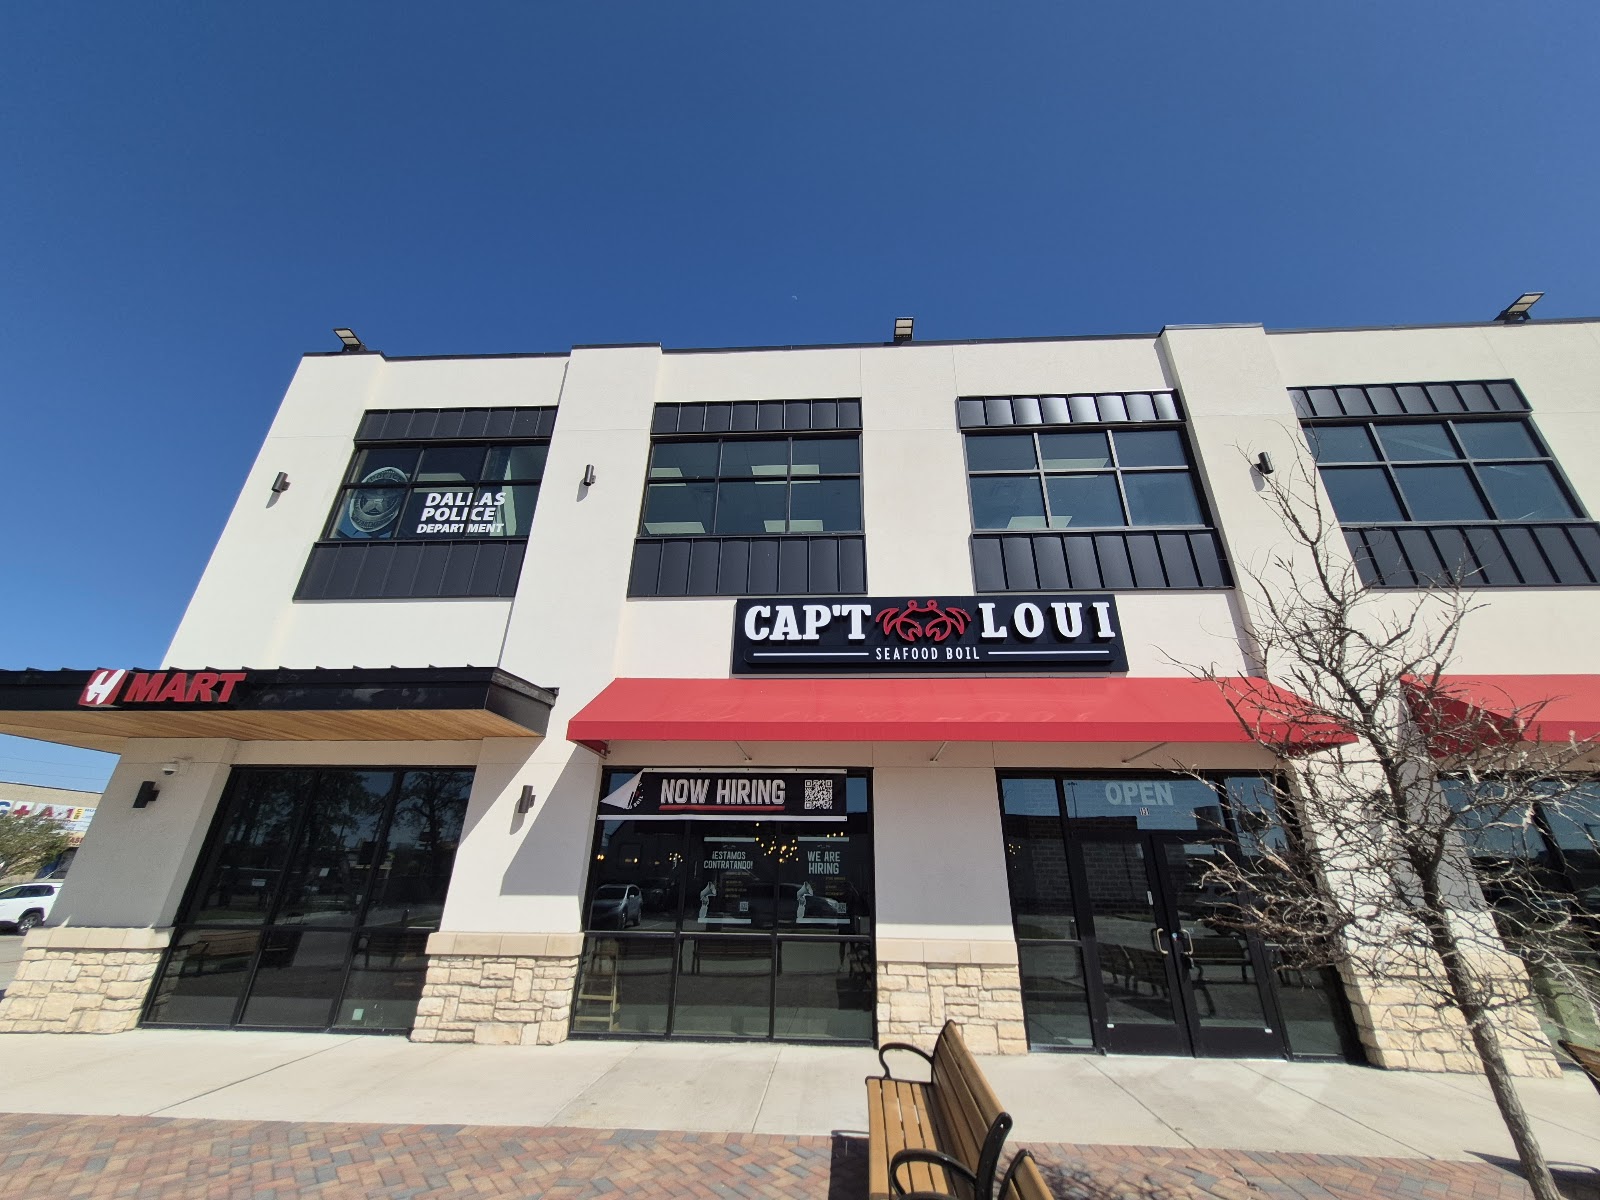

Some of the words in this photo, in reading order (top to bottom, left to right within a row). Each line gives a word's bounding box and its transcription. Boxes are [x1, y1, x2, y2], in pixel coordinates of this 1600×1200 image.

[425, 492, 507, 506] DALLAS
[420, 507, 496, 521] POLICE
[416, 523, 505, 534] DEPARTMENT
[743, 604, 872, 641] CAP'T
[977, 601, 1116, 639] LOUI
[875, 647, 938, 660] SEAFOOD
[946, 646, 980, 660] BOIL
[84, 669, 127, 705] H
[122, 672, 248, 703] MART
[660, 778, 711, 804] NOW
[716, 779, 786, 805] HIRING
[1104, 781, 1175, 806] OPEN
[807, 851, 822, 862] WE
[824, 851, 841, 862] ARE
[703, 860, 754, 870] CONTRATANDO!
[808, 863, 840, 875] HIRING
